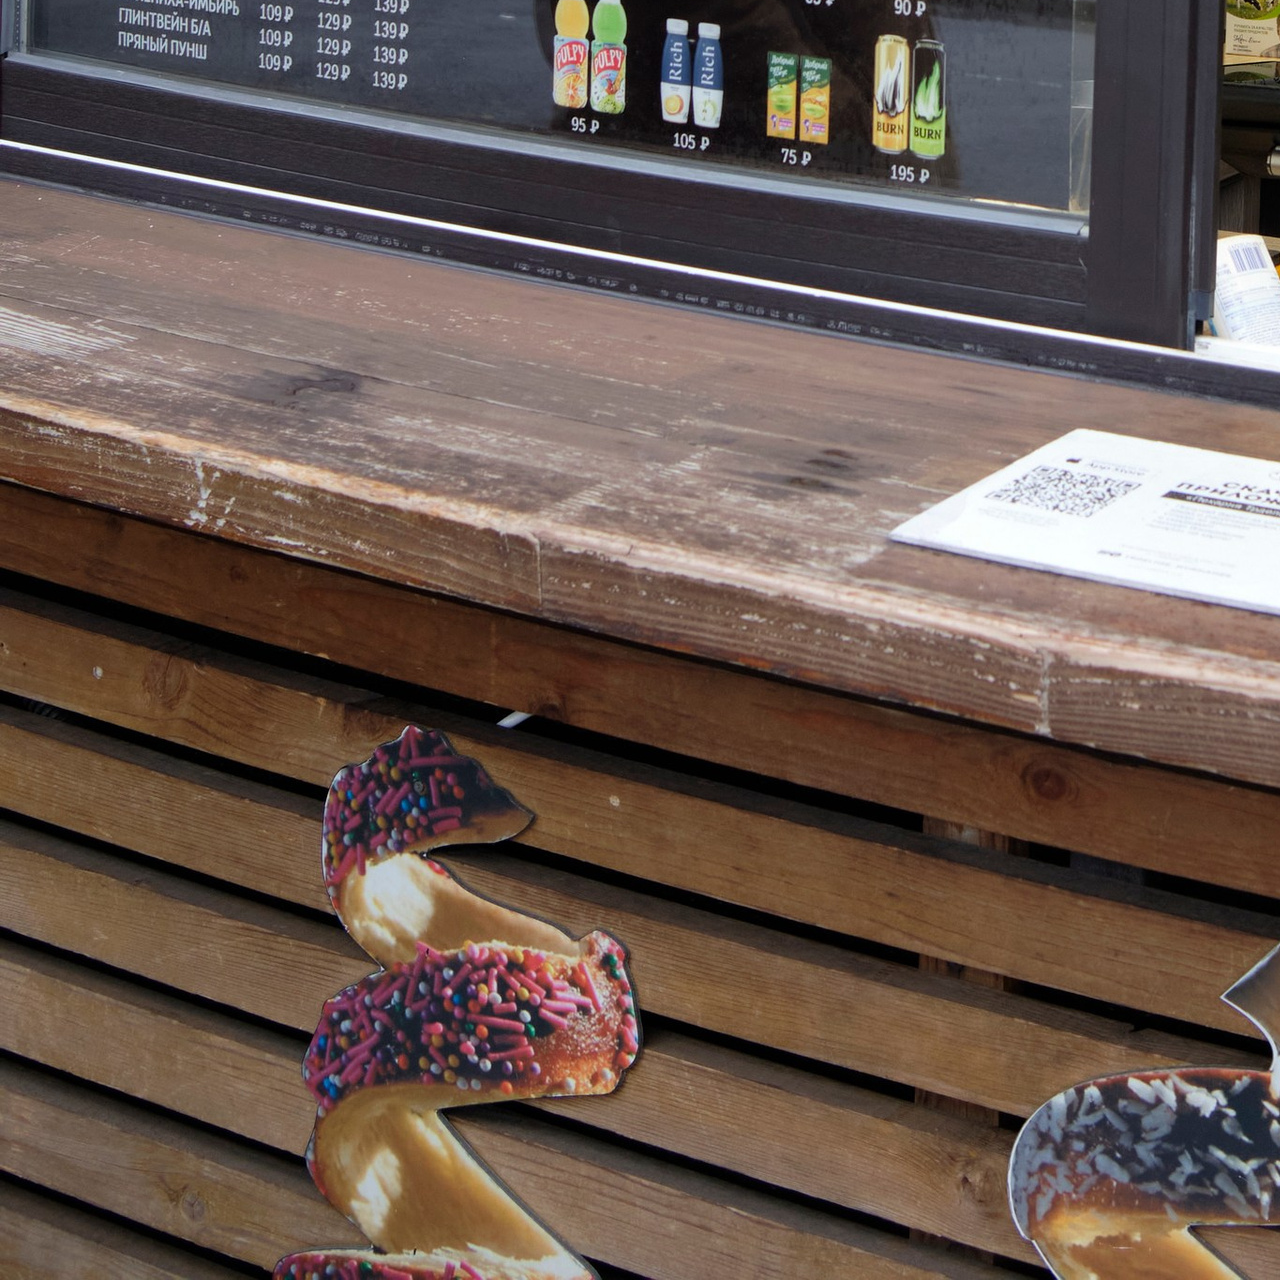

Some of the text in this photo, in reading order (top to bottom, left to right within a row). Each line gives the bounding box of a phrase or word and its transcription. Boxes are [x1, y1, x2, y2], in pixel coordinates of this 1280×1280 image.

[118, 7, 212, 37] ГЛИНТВЕЙН Б/А
[118, 31, 208, 59] ПРЯНЫЙ ПУНШ
[556, 45, 585, 68] PULPY
[593, 51, 622, 72] PULPY
[669, 42, 683, 81] Rich
[701, 46, 715, 85] Rich
[876, 121, 904, 135] BURN
[914, 127, 942, 140] BURN
